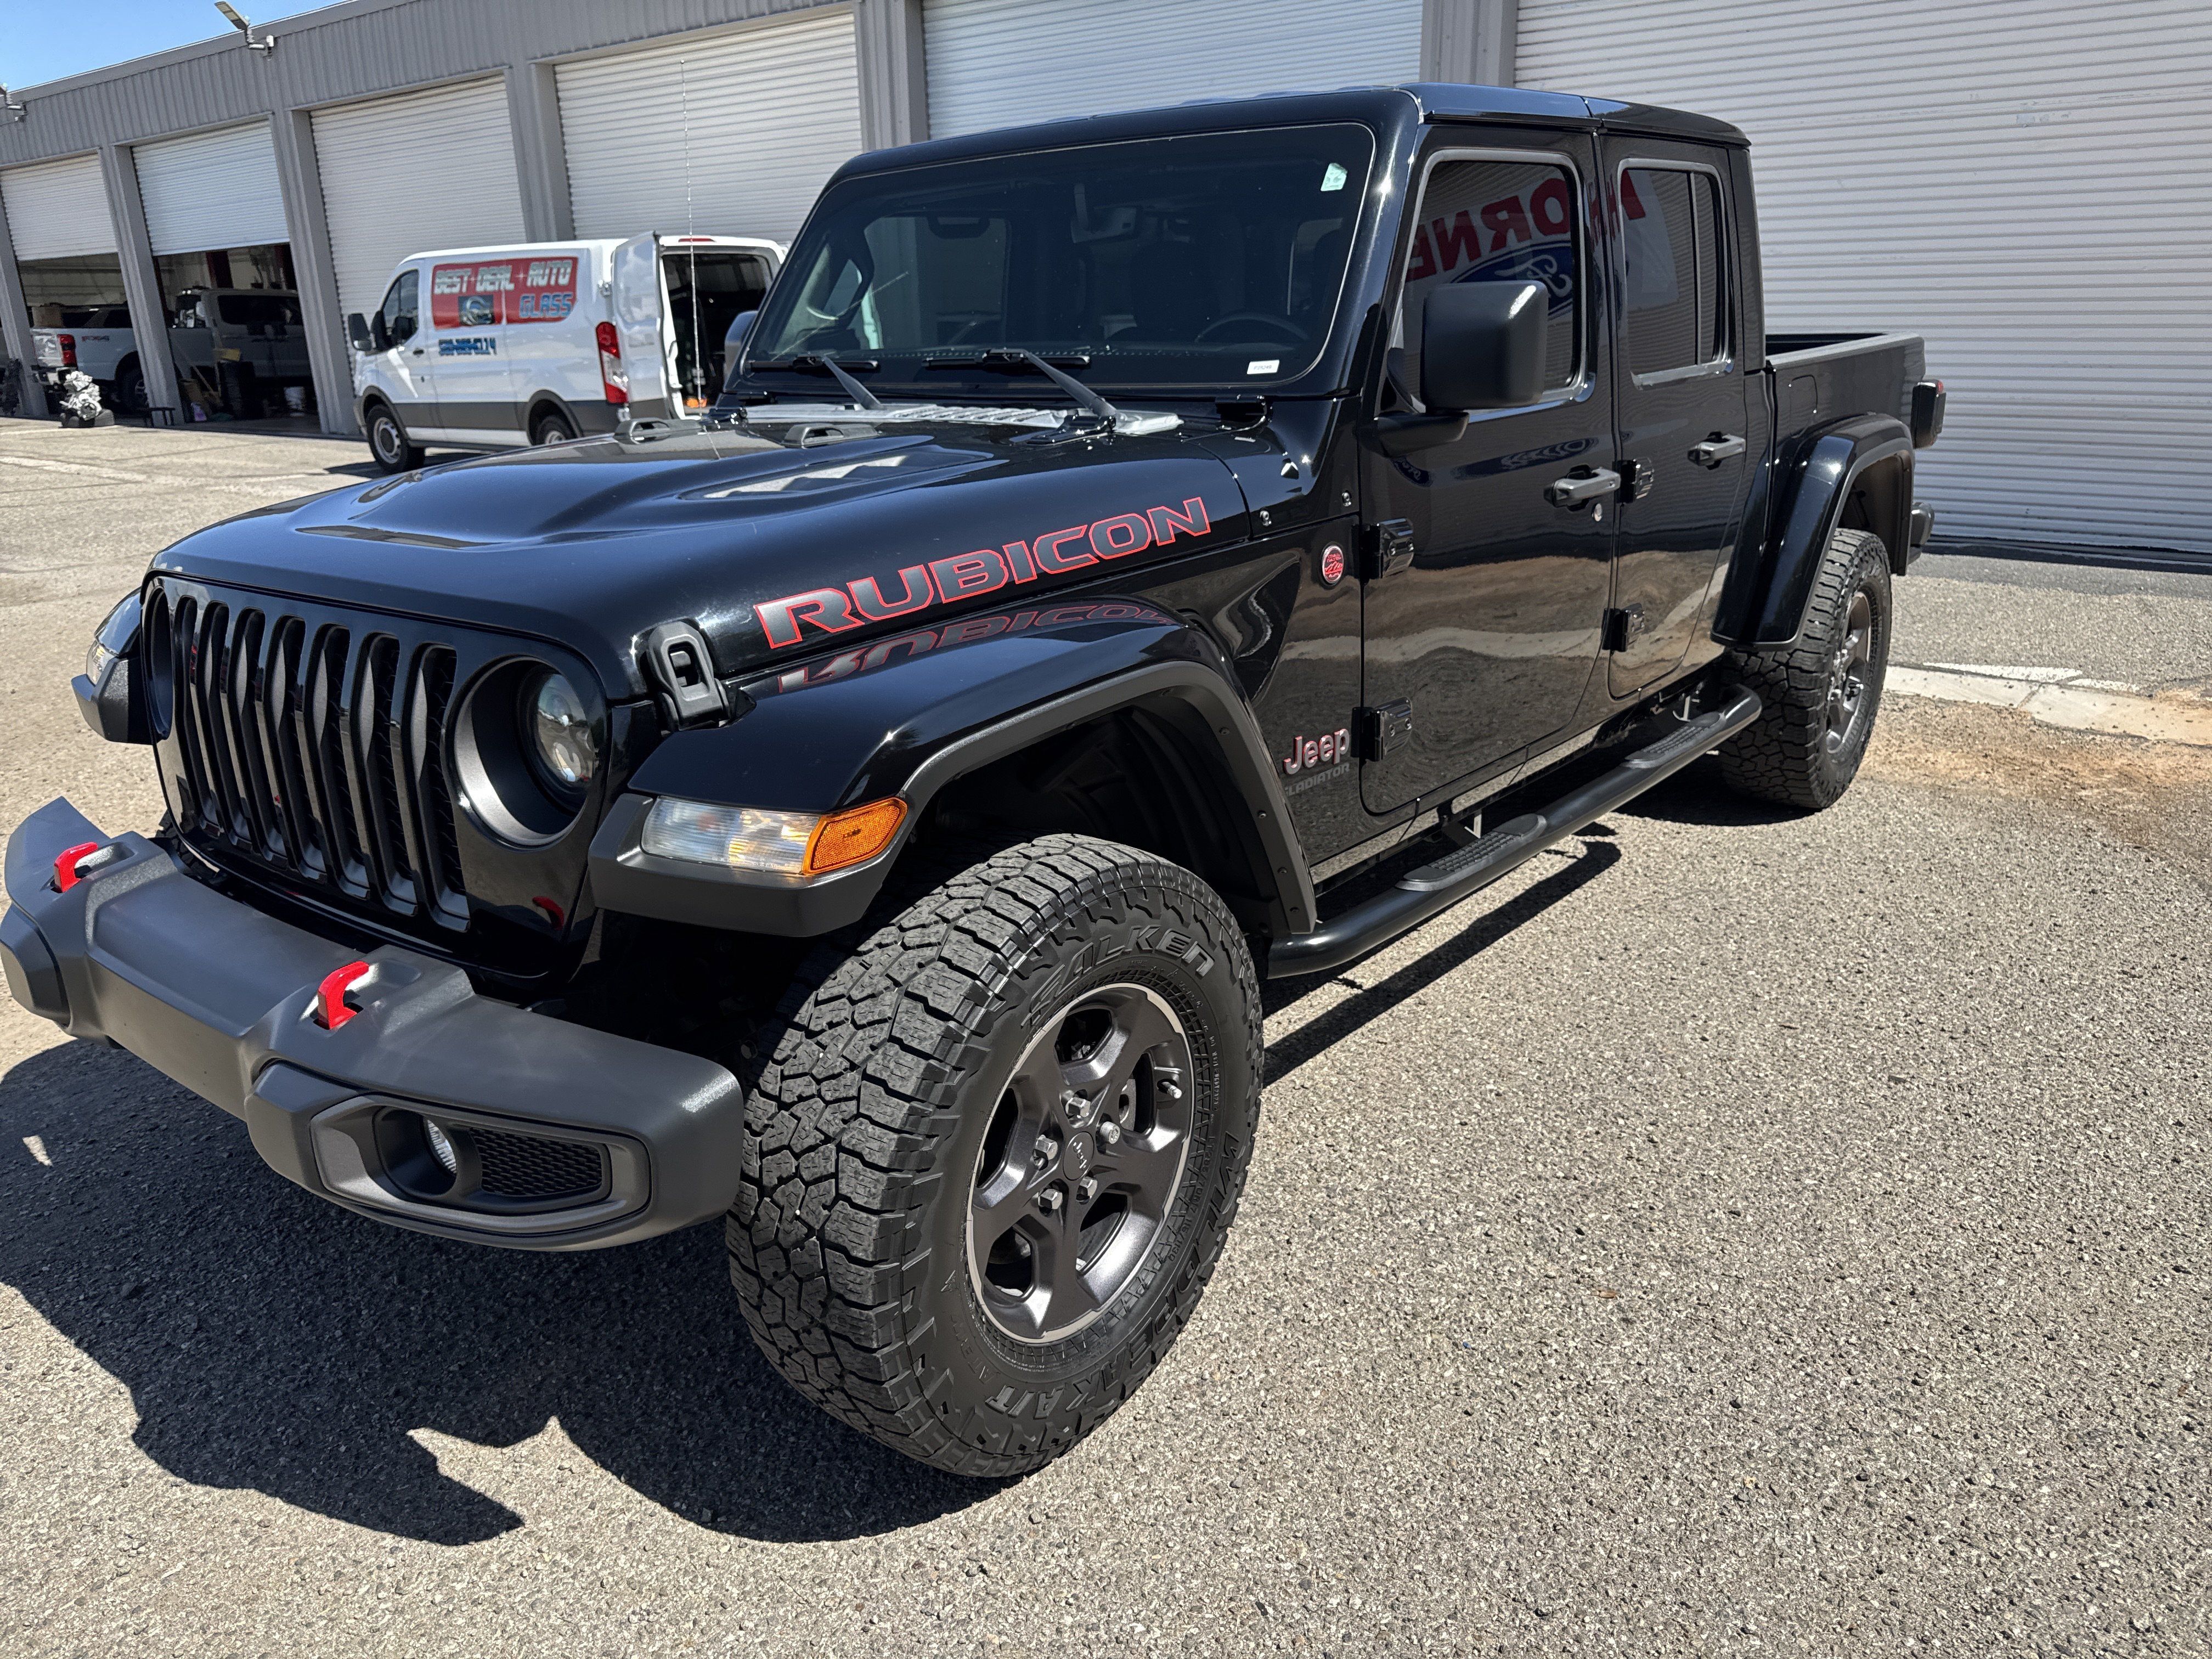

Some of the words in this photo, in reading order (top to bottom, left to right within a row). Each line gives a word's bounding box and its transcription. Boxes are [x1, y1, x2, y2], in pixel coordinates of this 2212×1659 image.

[434, 268, 472, 295] BEST
[476, 265, 515, 292] DEAL
[527, 259, 573, 287] AUTO
[519, 291, 574, 318] GLASS
[754, 496, 1210, 649] RUBICON
[1284, 729, 1350, 775] Jeep
[1021, 925, 1215, 1029] FALKEN
[1065, 1131, 1240, 1412] WILDPEAK
[985, 1382, 1066, 1420] A/T
